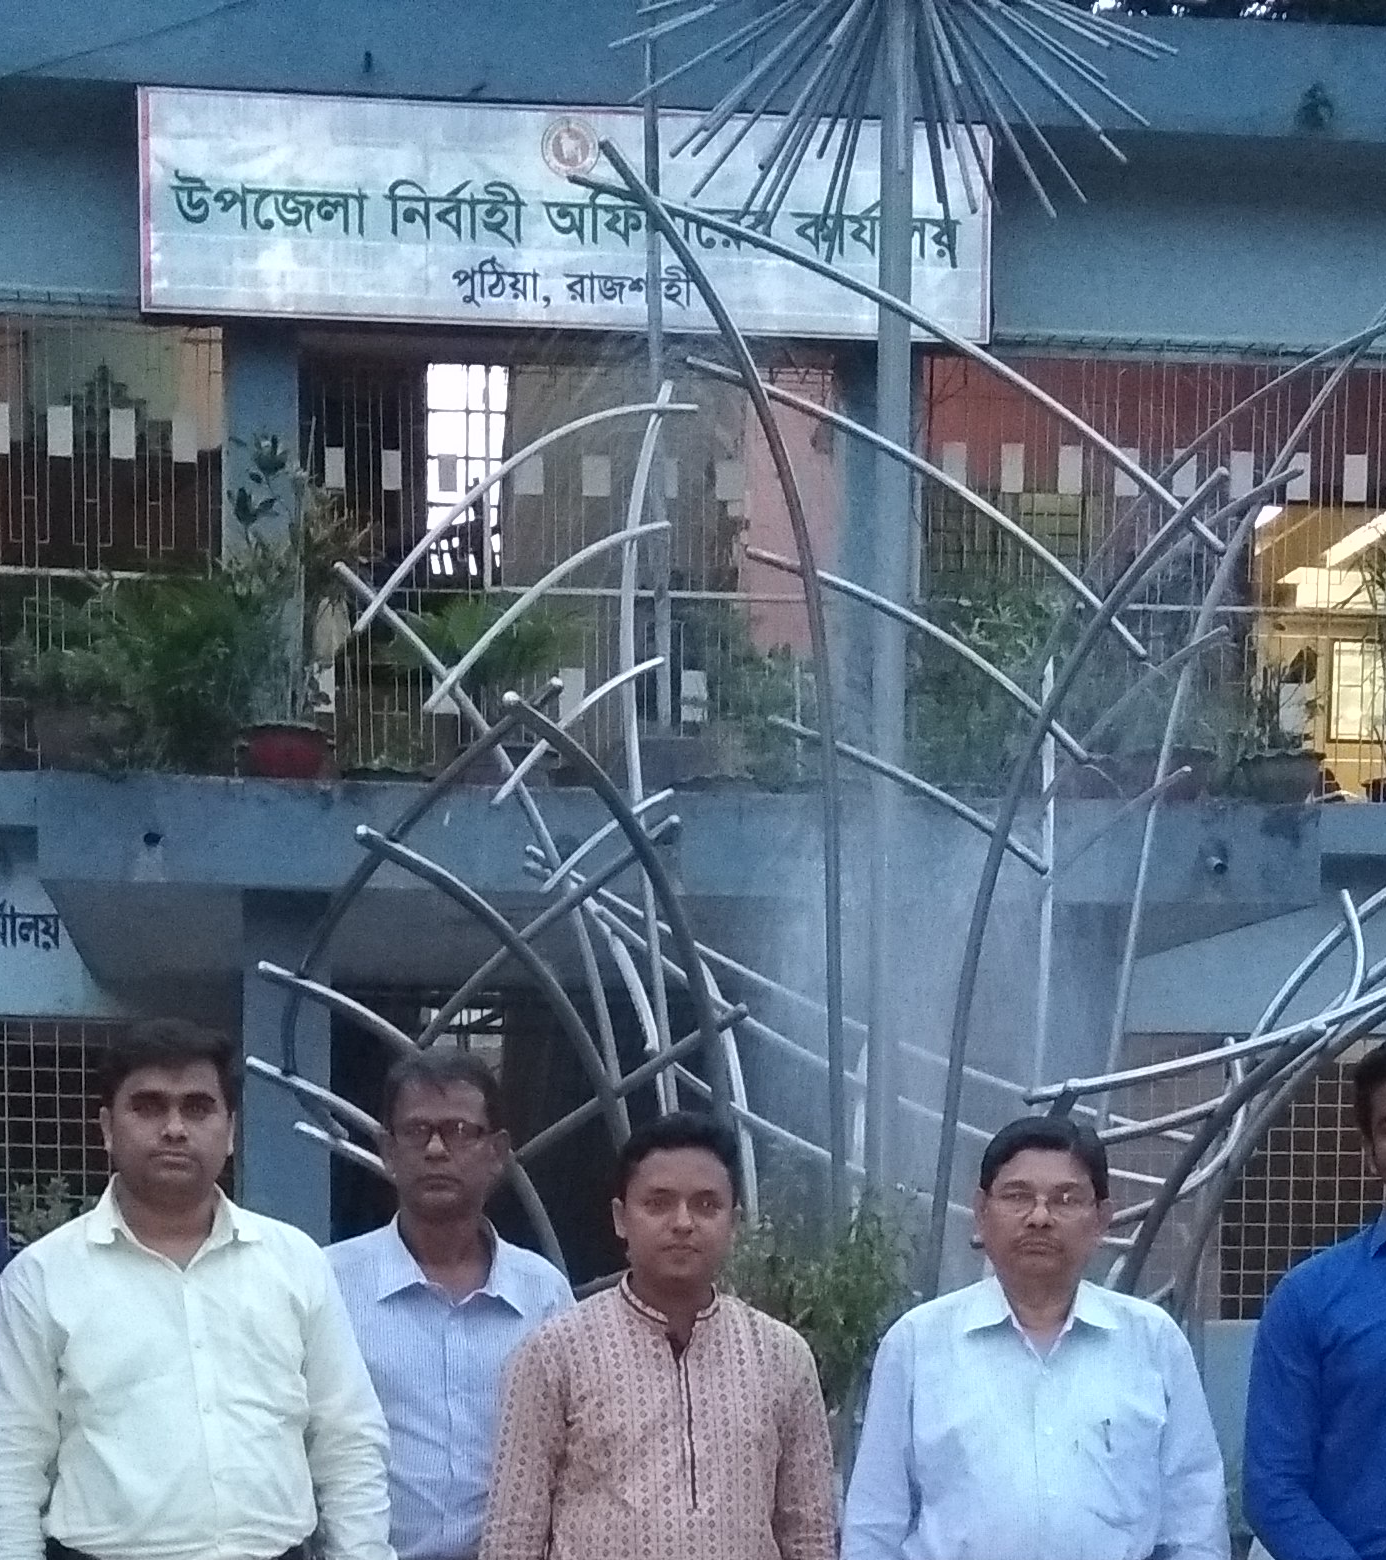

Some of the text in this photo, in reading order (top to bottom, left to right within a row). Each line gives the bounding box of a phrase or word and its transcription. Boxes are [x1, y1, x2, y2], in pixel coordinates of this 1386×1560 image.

[170, 170, 369, 237] উপজেলা
[383, 179, 527, 248] নির্বাহী
[452, 255, 551, 308] পুঠিয়া,
